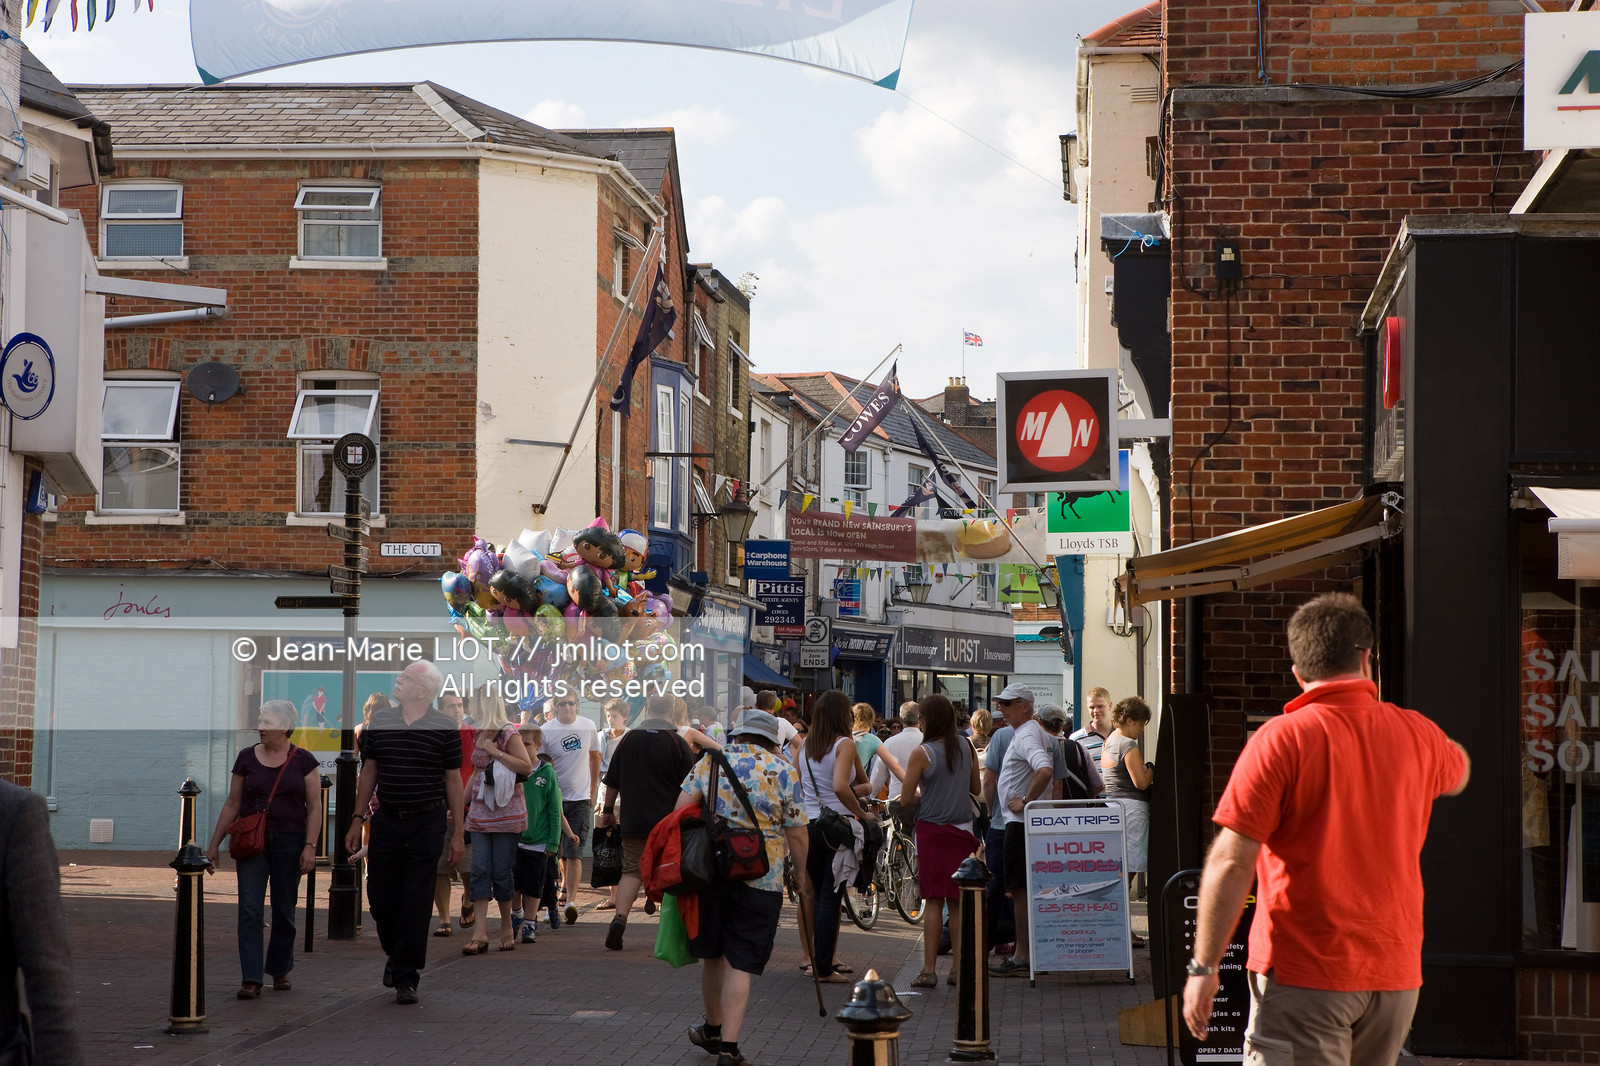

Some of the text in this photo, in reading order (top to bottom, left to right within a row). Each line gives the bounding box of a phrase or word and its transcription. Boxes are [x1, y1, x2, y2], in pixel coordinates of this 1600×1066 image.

[791, 527, 815, 536] LOCAL
[813, 519, 840, 528] BRAND
[862, 521, 912, 532] SAINSBURY'S
[385, 544, 438, 556] THE CUT
[1060, 538, 1118, 552] Lloyds TSB
[750, 552, 787, 560] Carphone
[758, 583, 803, 594] Pittis
[764, 616, 796, 624] 292345
[905, 637, 1012, 663] Ironmonger HURST Housewares
[1526, 647, 1600, 682] SA
[1526, 693, 1600, 728] SA
[1526, 738, 1600, 773] SO
[1031, 815, 1120, 826] BOAT TRIPS
[1047, 841, 1105, 855] 1 HOUR
[1034, 859, 1120, 873] RIB RIDES
[1062, 903, 1085, 912] PER
[1087, 902, 1118, 912] HEAD
[1219, 963, 1242, 971] aining
